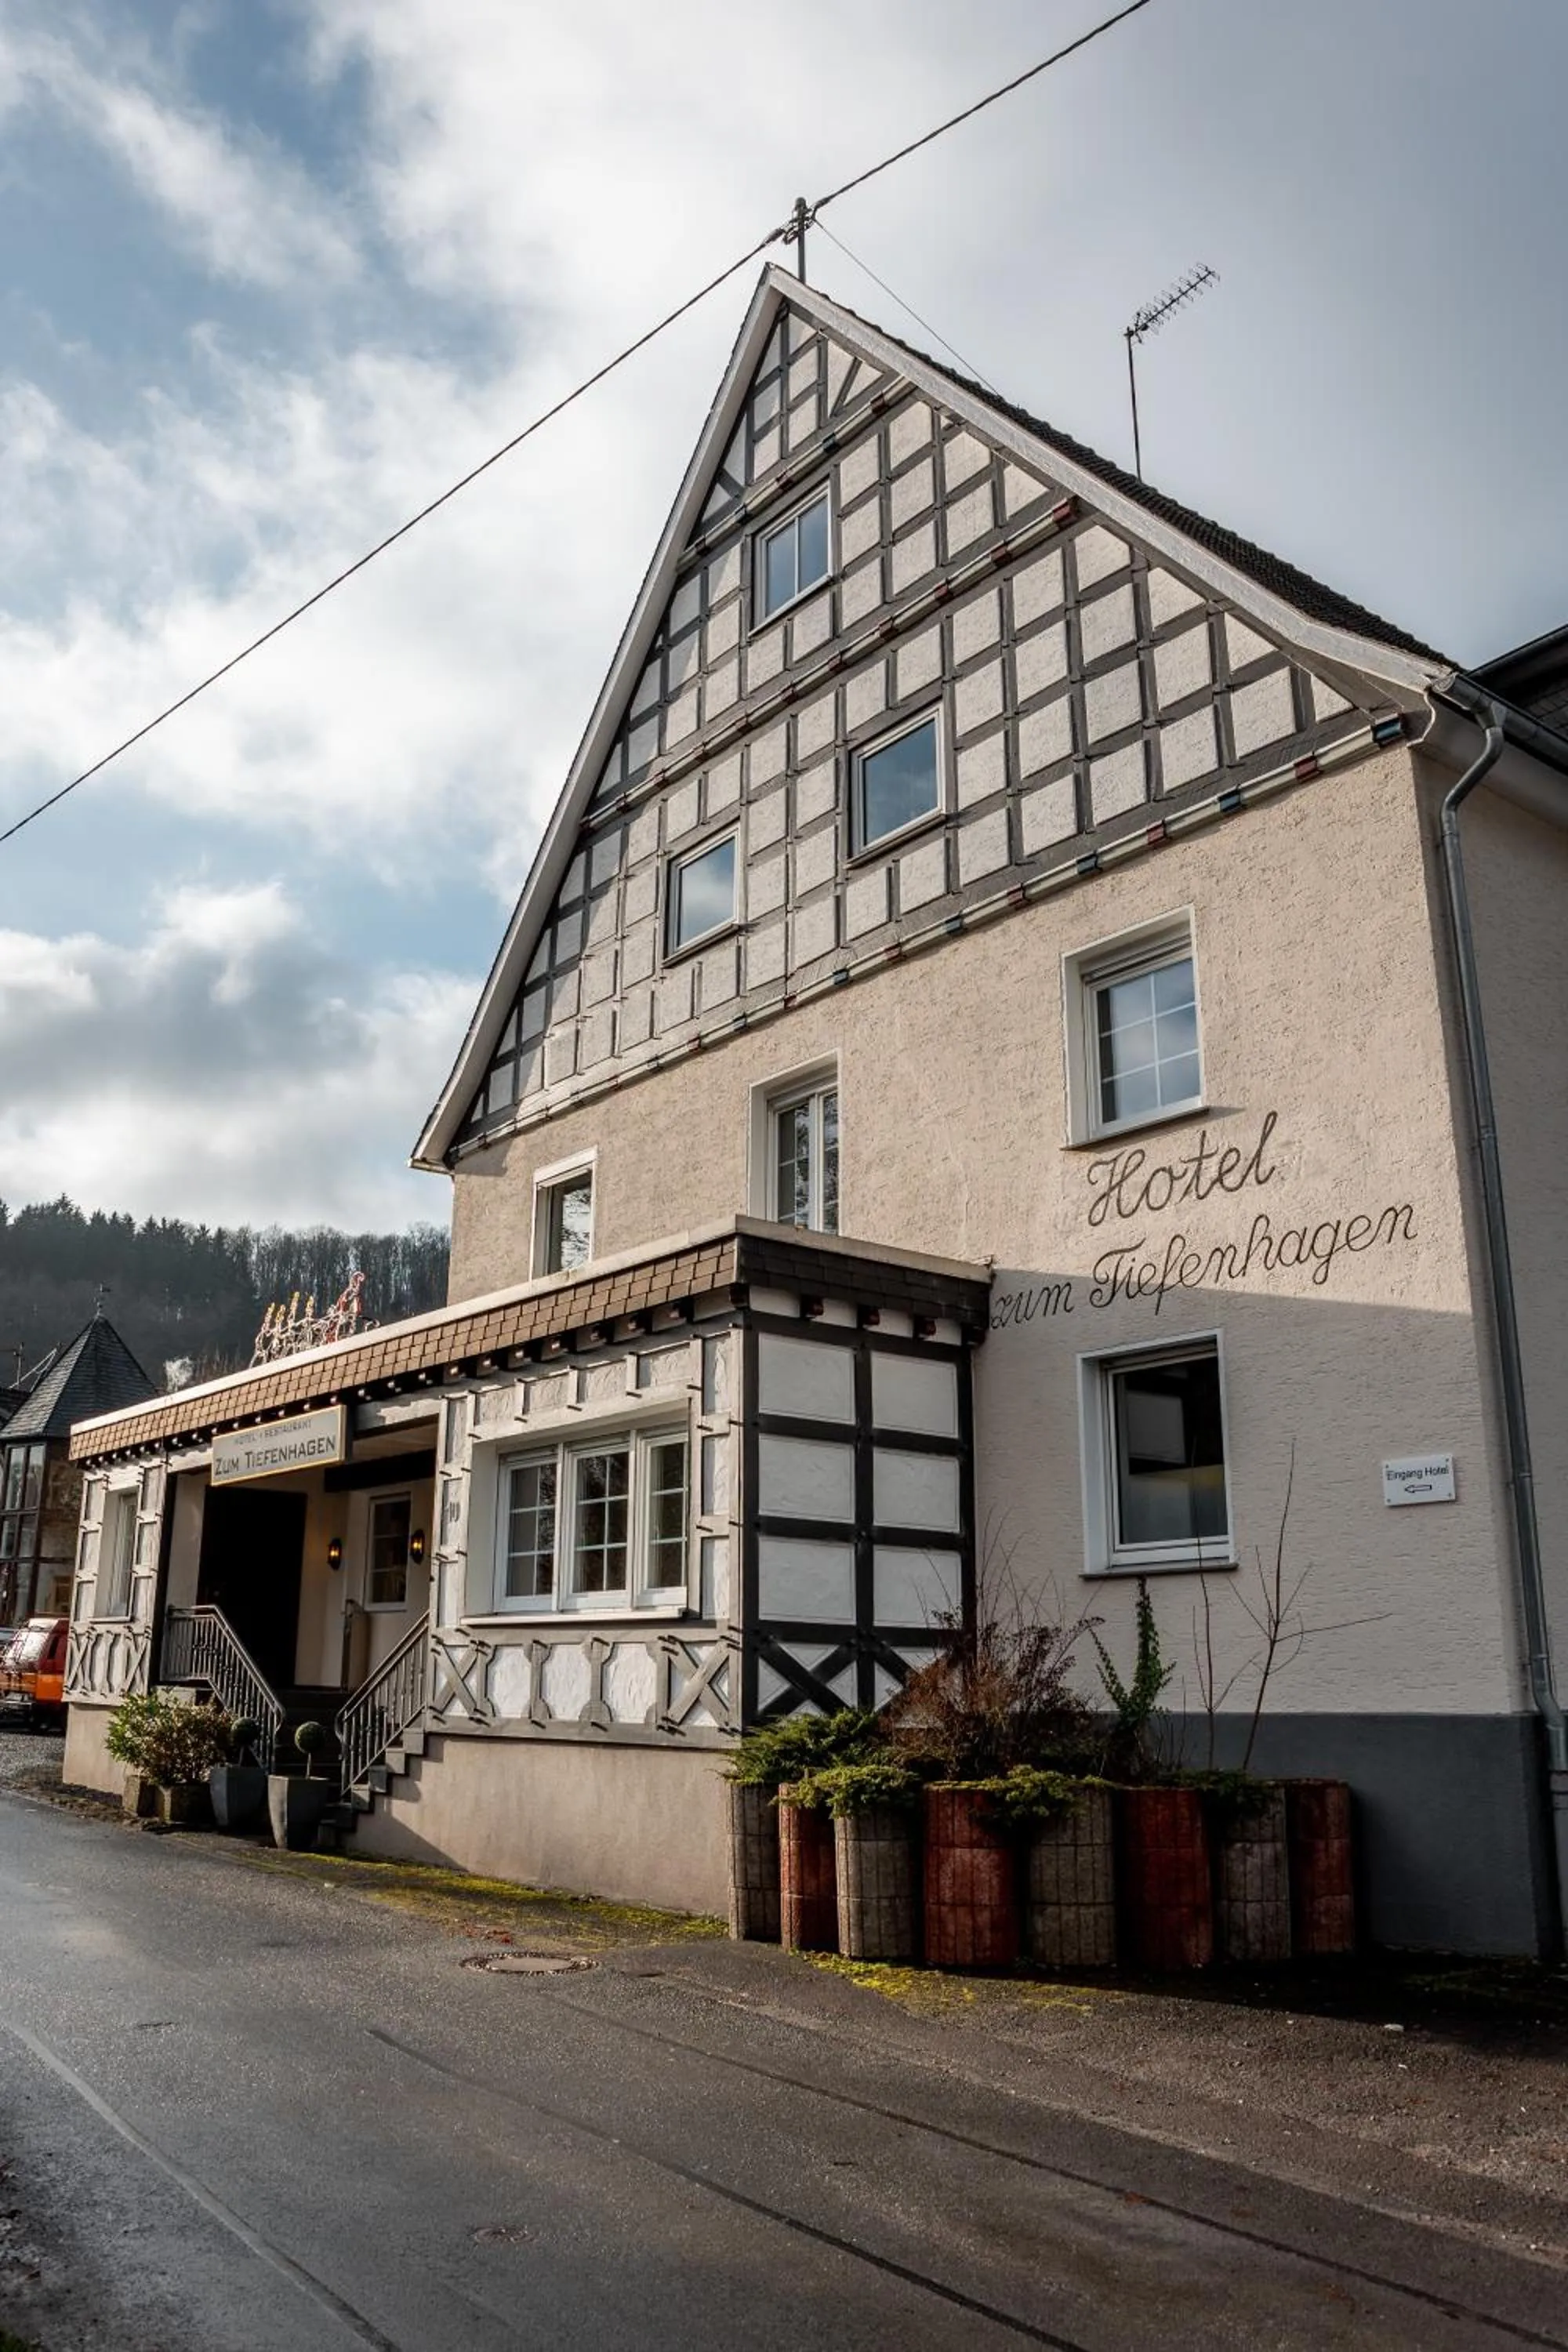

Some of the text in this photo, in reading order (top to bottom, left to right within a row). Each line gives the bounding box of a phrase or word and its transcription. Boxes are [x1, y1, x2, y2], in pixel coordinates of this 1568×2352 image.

[1087, 1110, 1278, 1226] Hotel
[991, 1203, 1418, 1330] zum Tiefenhagen
[215, 1436, 336, 1475] ZUM TIEFENHAGEN
[1385, 1465, 1450, 1481] Eingang Hotel
